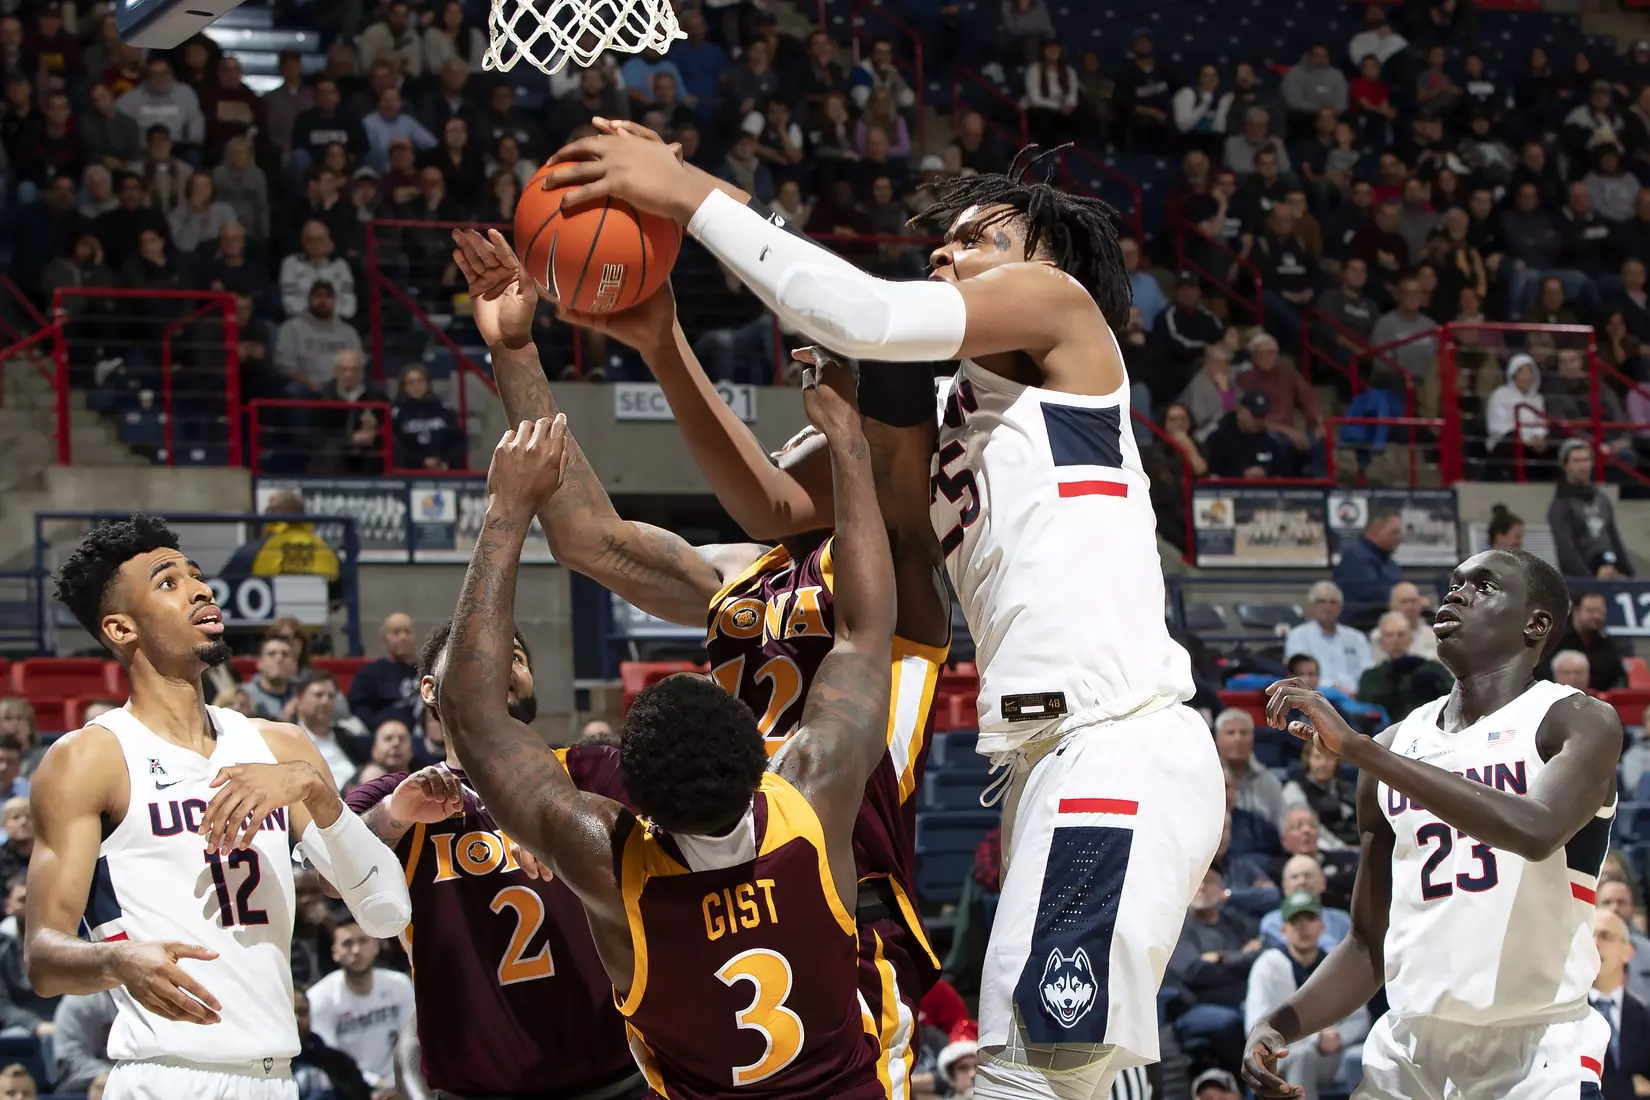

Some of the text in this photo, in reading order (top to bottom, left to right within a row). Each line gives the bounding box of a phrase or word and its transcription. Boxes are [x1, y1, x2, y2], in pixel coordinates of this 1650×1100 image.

[620, 391, 665, 413] SEC
[705, 585, 833, 648] IONA
[1048, 698, 1061, 709] 48
[148, 798, 286, 838] UCN
[1388, 759, 1527, 817] UNN
[203, 847, 269, 928] 12
[1416, 822, 1499, 901] 23
[489, 885, 555, 987] 2
[701, 878, 779, 941] GIST
[713, 947, 805, 1087] 3
